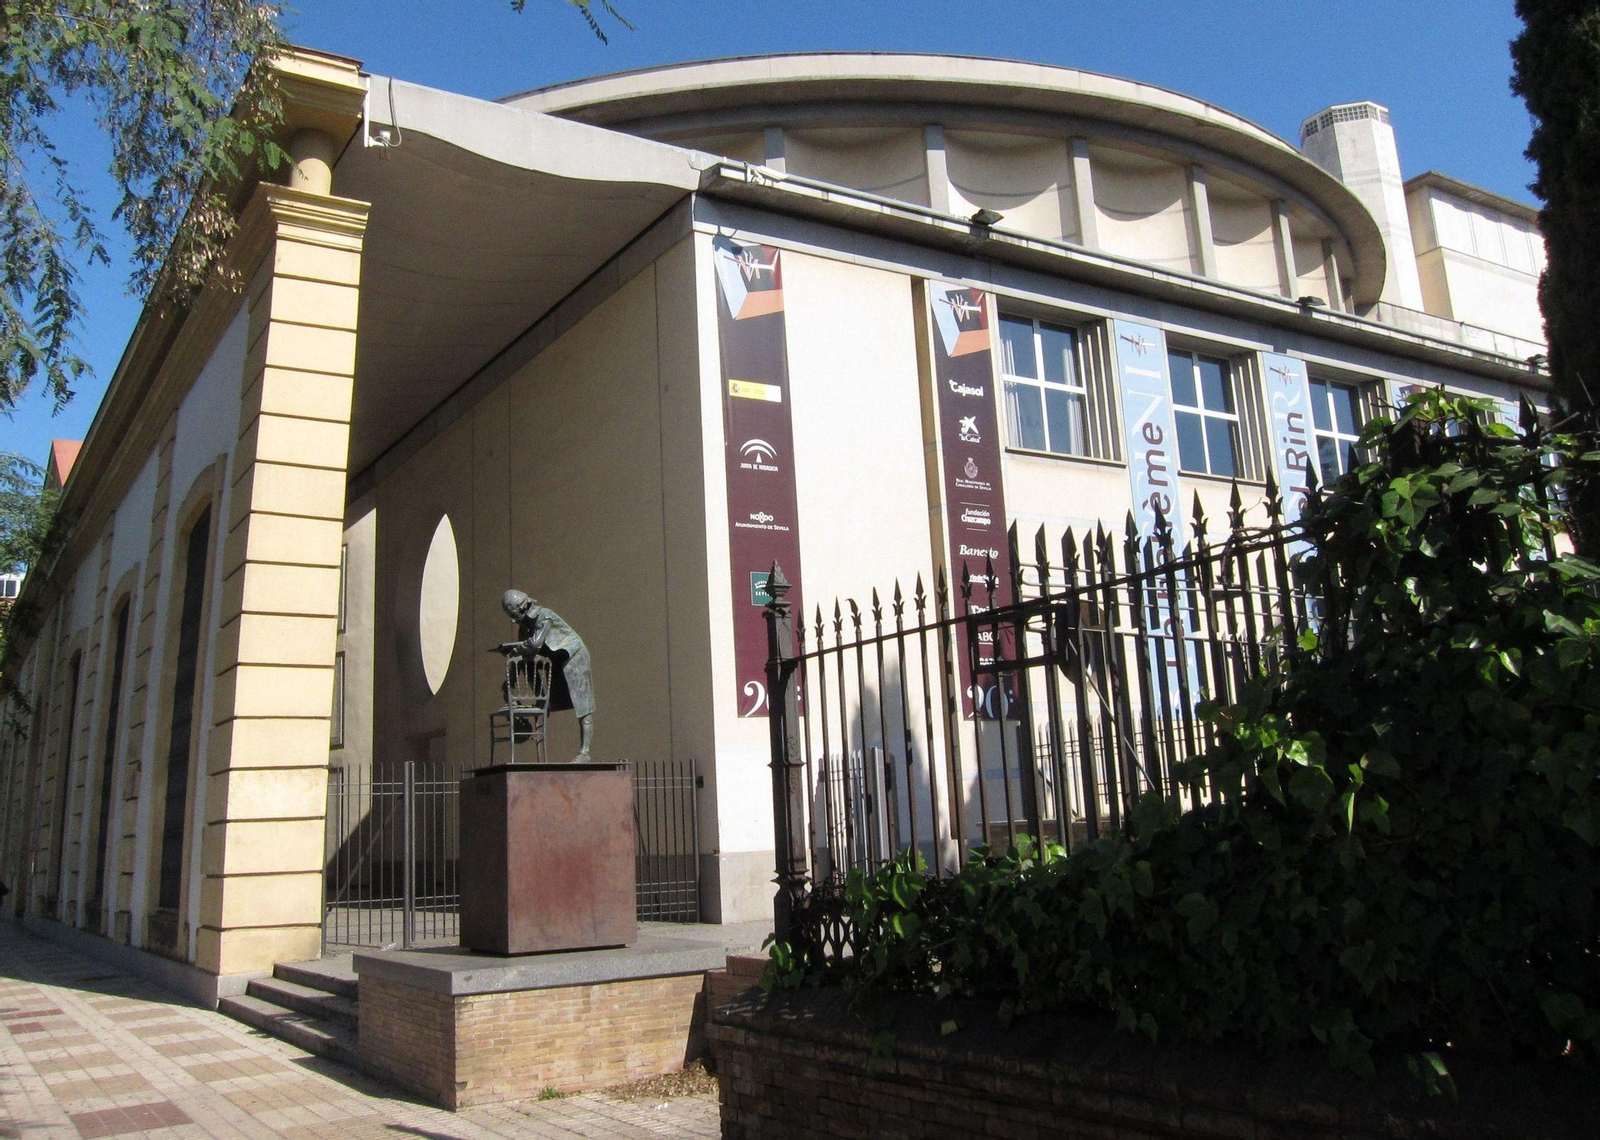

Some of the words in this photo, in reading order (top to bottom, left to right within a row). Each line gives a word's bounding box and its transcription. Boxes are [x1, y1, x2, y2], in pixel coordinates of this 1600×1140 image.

[948, 379, 984, 397] Cajasol
[1282, 412, 1308, 472] Rin
[959, 544, 999, 560] Banesto
